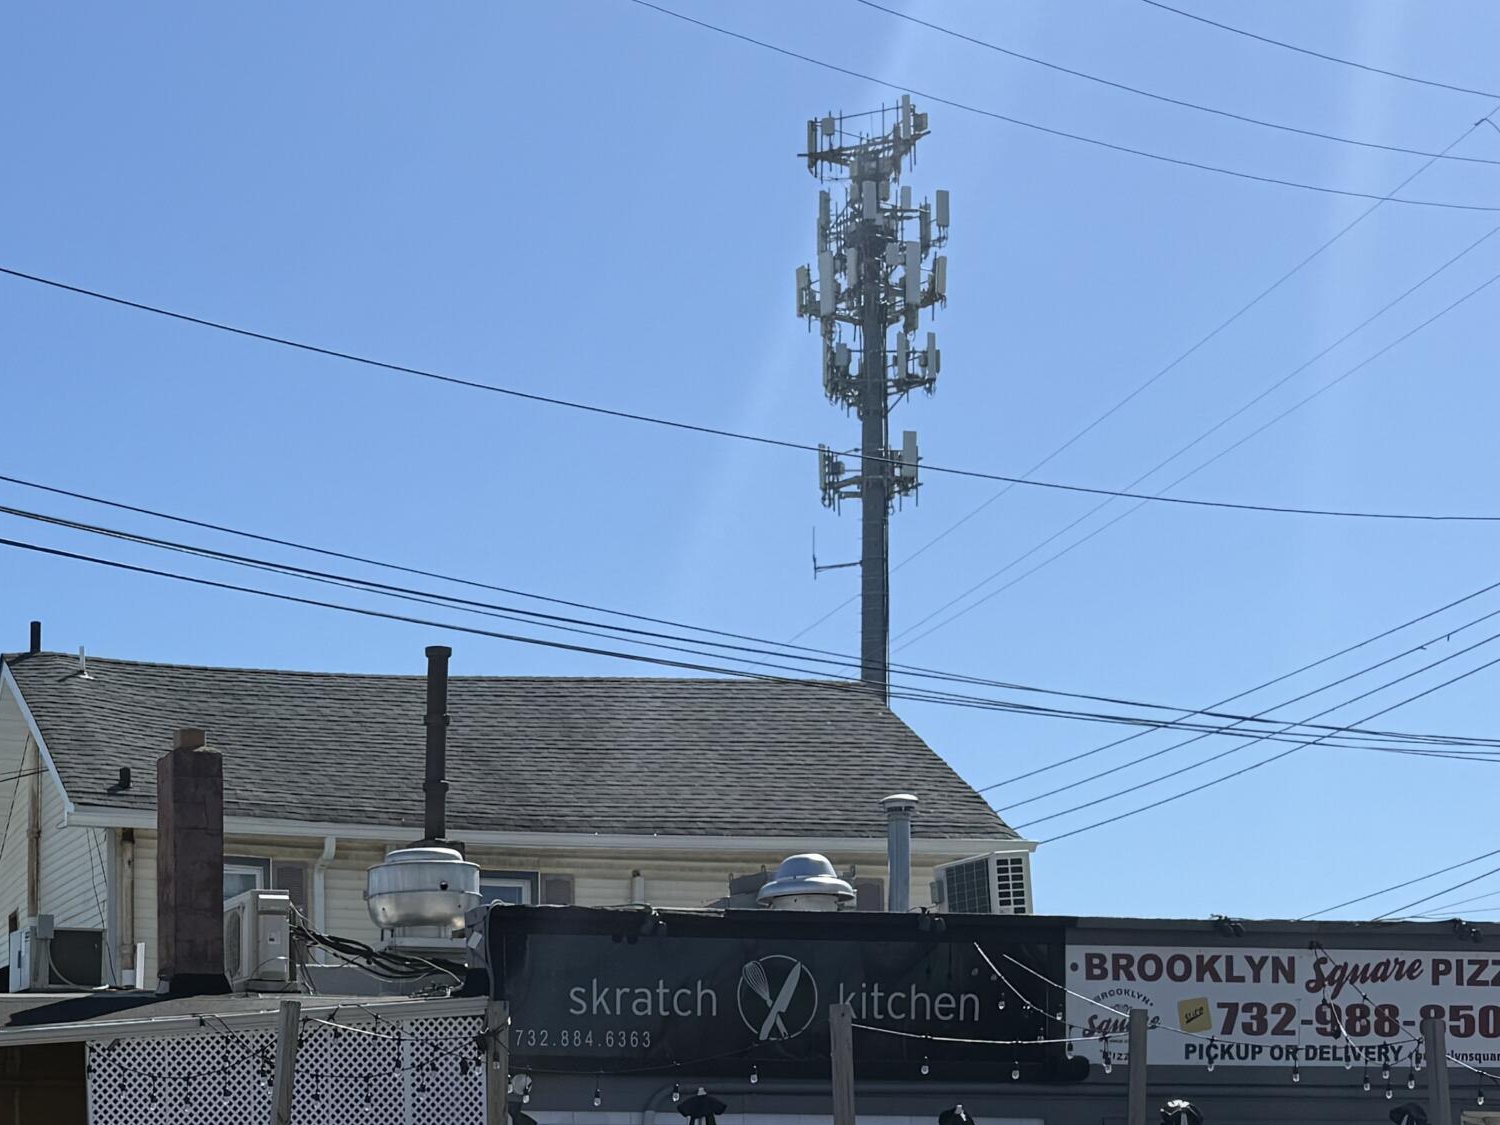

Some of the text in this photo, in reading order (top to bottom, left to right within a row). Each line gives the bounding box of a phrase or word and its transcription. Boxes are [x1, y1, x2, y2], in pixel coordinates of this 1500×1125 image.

[1085, 953, 1296, 984] BROOKLYN
[1305, 956, 1424, 1000] Square
[569, 979, 980, 1021] skratch kitchen
[515, 1029, 652, 1048] 732.884.6363
[1184, 1043, 1402, 1062] PICKUP OR DELIVERY
